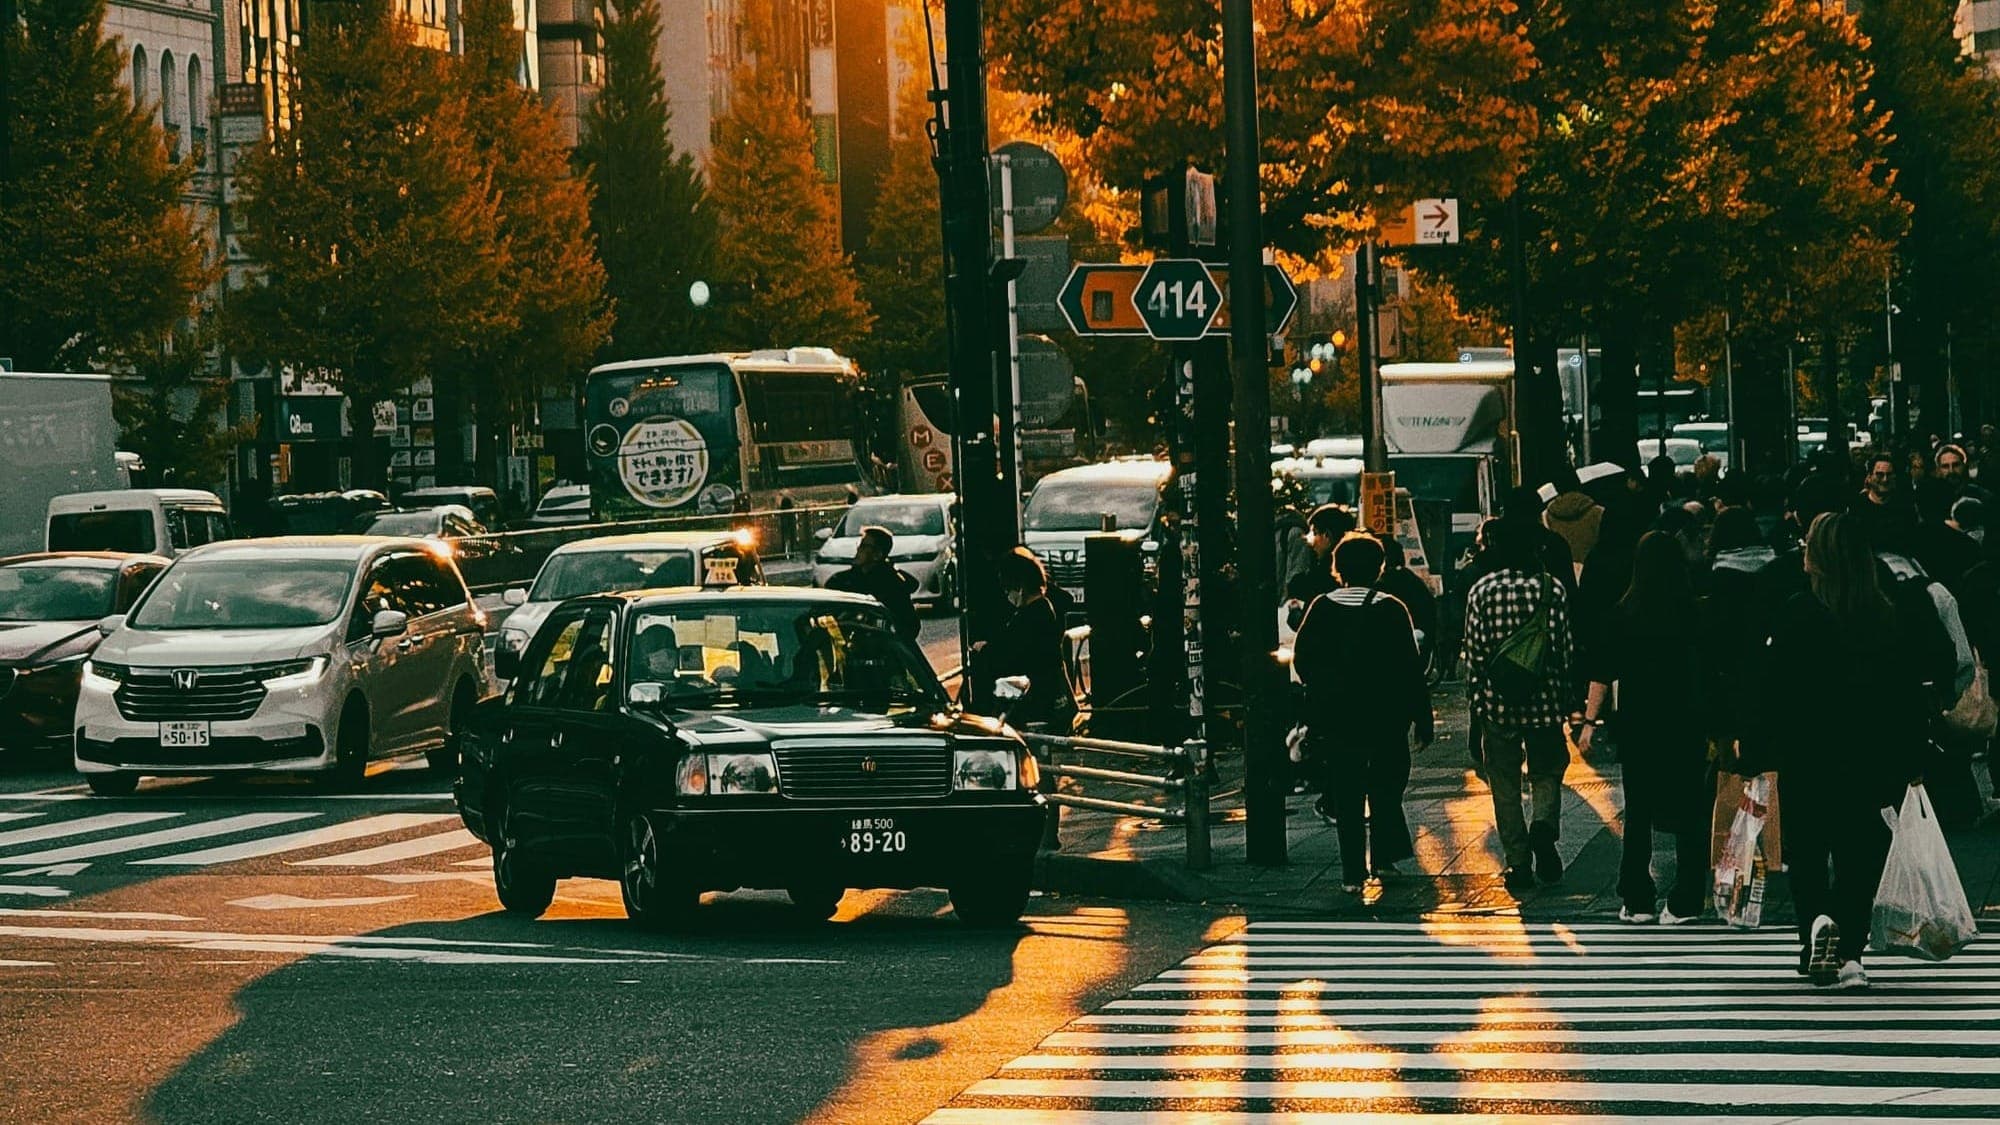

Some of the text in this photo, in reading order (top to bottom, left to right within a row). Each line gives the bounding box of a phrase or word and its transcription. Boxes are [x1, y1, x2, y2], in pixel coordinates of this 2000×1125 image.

[1148, 280, 1208, 318] 414
[874, 818, 894, 830] 500
[850, 831, 906, 853] 89-20
